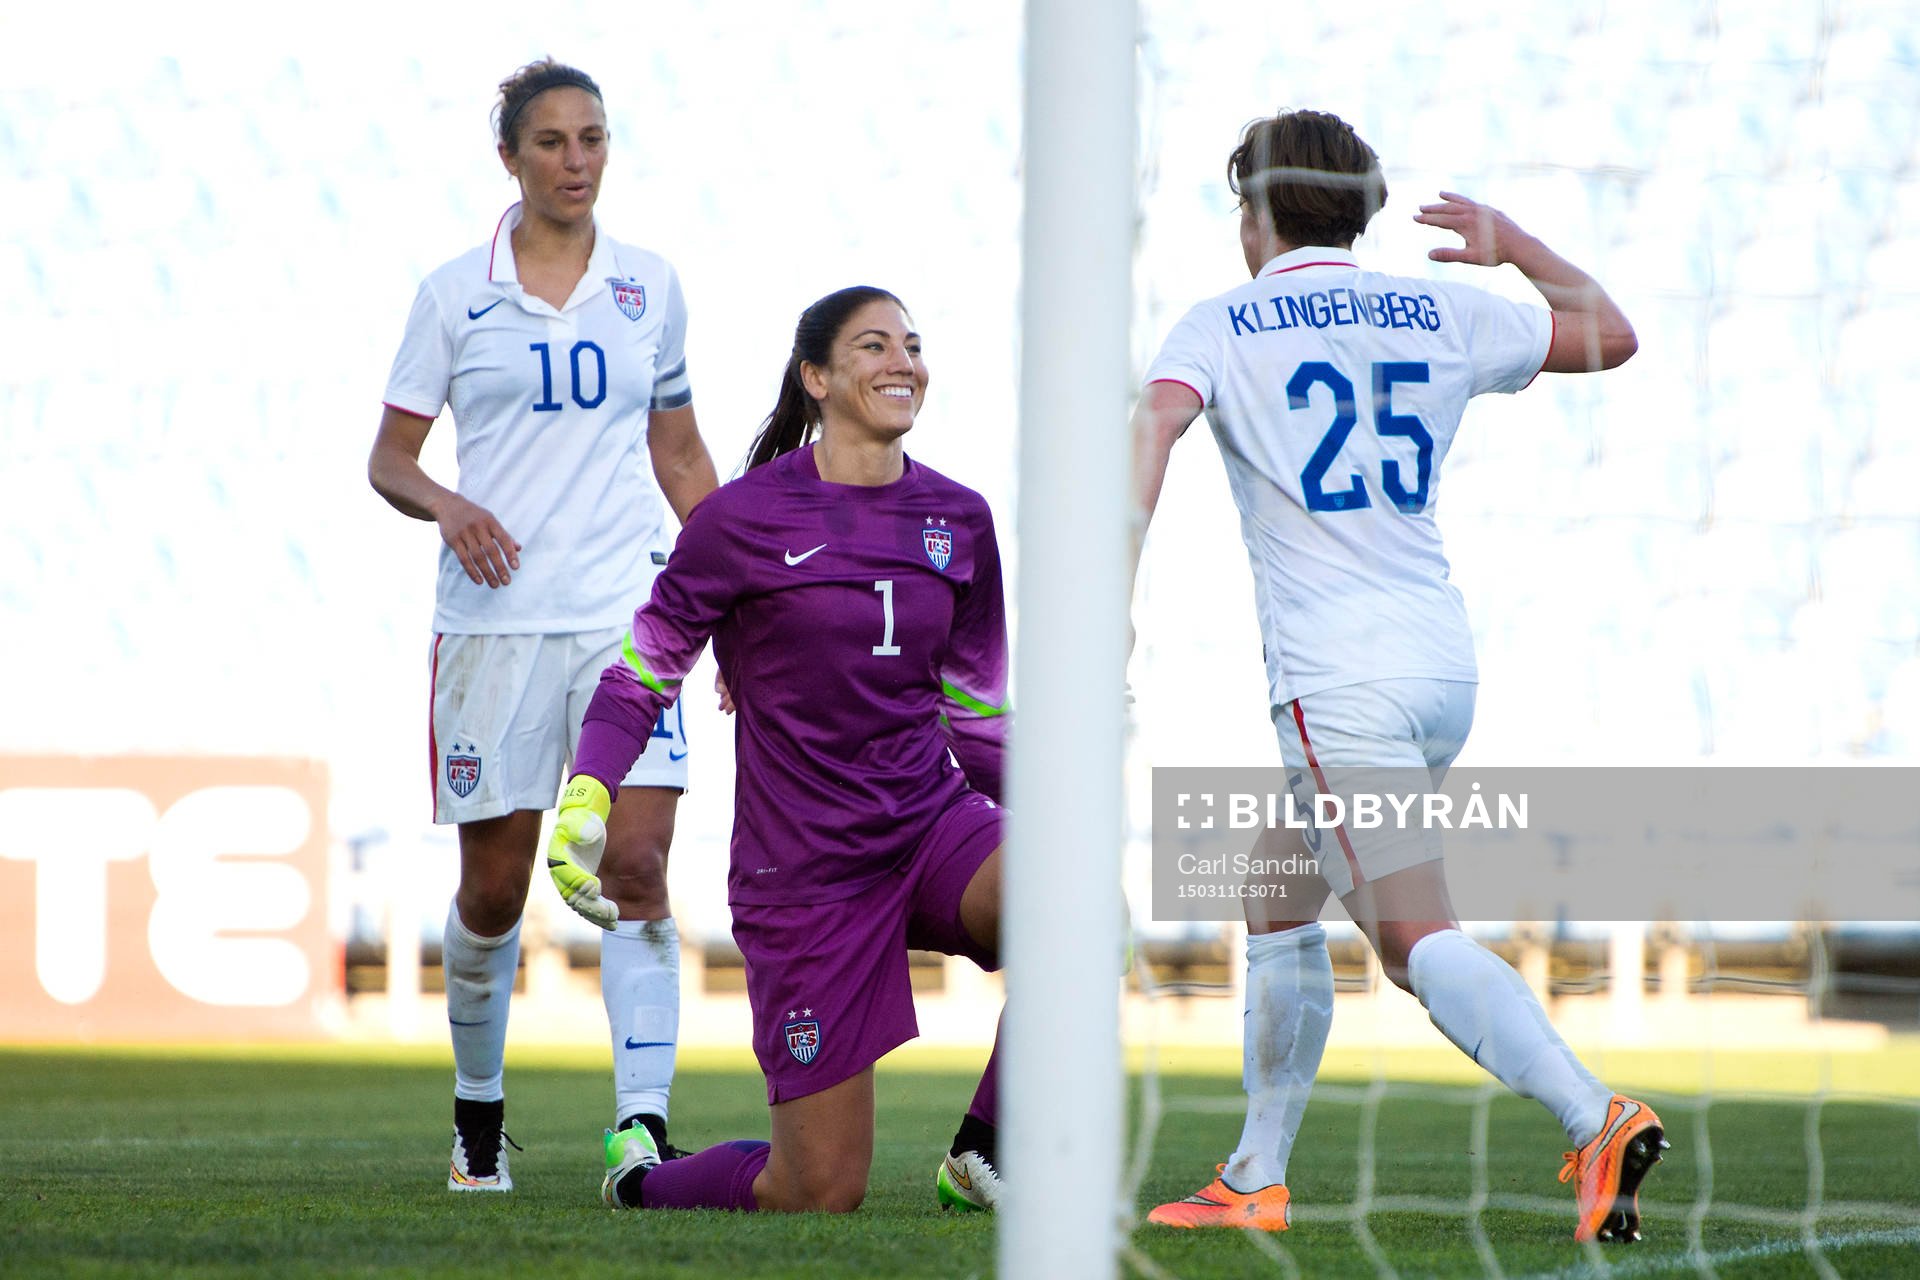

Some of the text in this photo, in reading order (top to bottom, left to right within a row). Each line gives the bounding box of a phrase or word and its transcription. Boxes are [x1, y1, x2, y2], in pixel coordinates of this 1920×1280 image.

[1228, 288, 1441, 336] KLINGENBERG
[529, 340, 607, 412] 10
[1286, 361, 1434, 514] 25
[872, 580, 901, 656] 1
[0, 786, 312, 1005] TE
